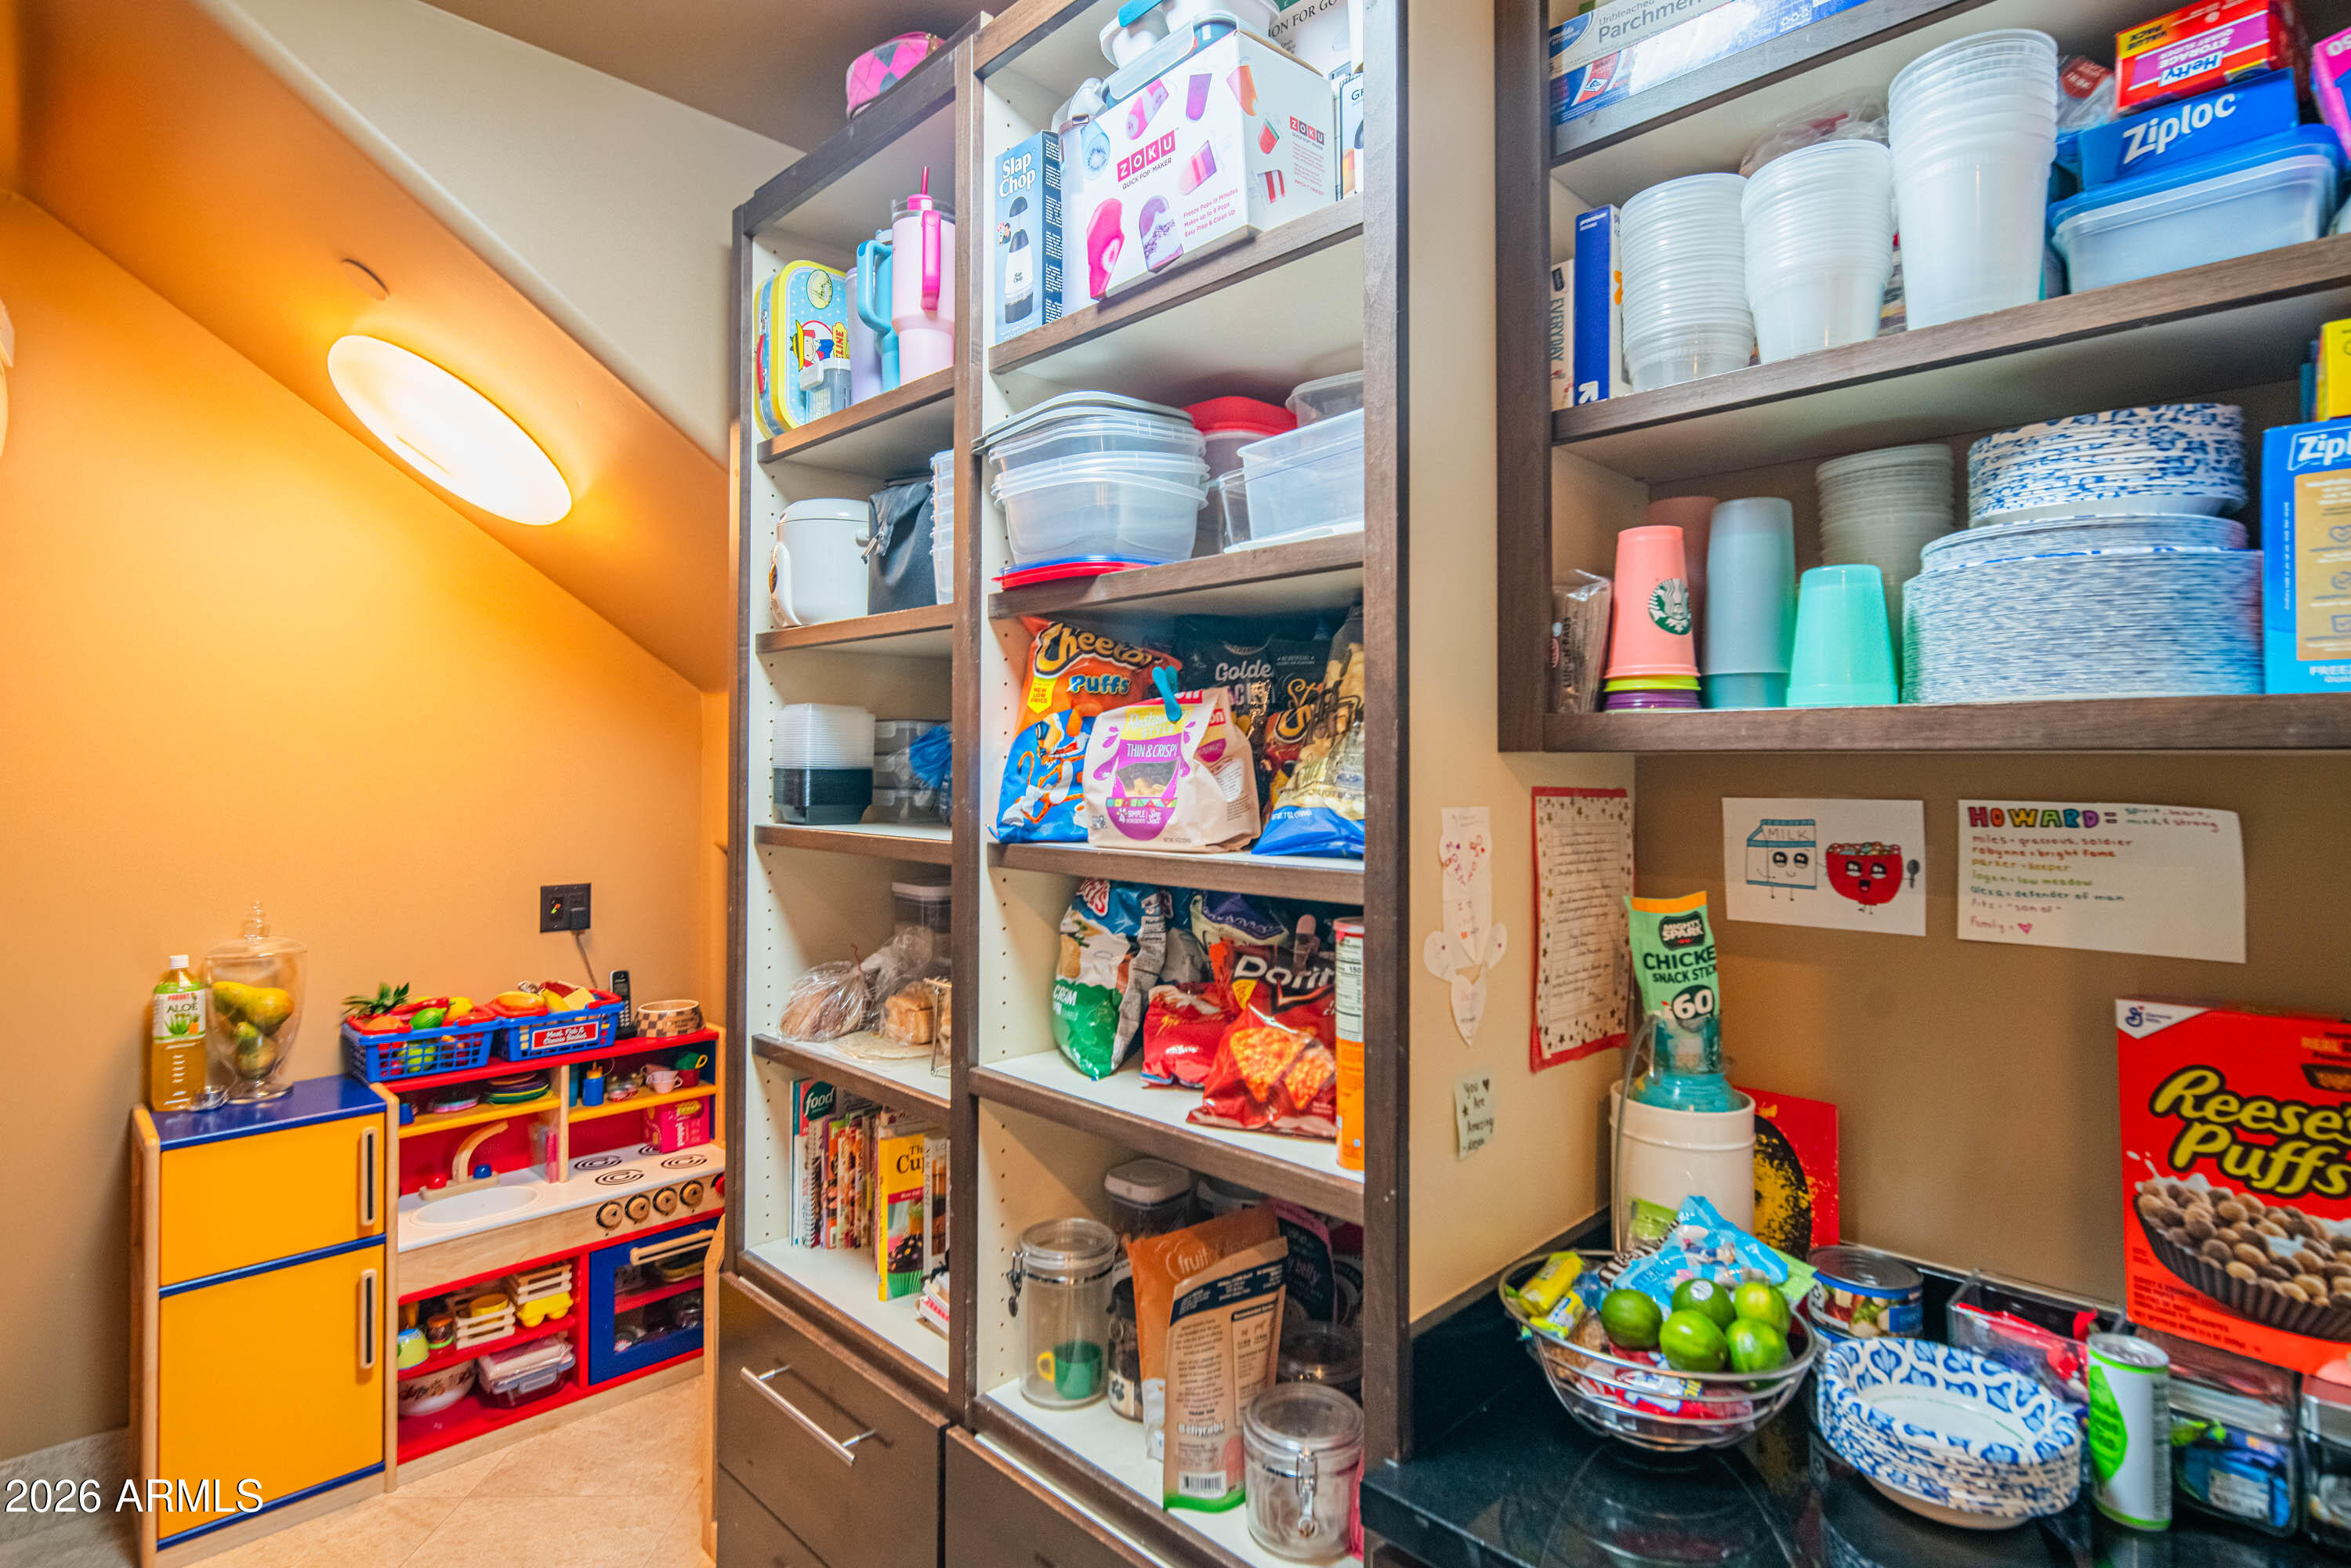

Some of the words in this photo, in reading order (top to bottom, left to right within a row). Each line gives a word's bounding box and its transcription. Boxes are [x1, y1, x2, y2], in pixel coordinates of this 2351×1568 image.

[1292, 5, 1316, 27] FOR
[2157, 37, 2230, 70] STORAGE
[2164, 54, 2219, 81] Hefty
[1291, 118, 1324, 143] ZOKU
[2122, 92, 2236, 165] Ziploc
[1002, 151, 1032, 179] Slap
[1119, 136, 1173, 178] ZOKU
[998, 168, 1036, 199] Chop
[1122, 176, 1139, 190] QUICK
[1139, 169, 1151, 180] POP
[1152, 158, 1172, 172] MAKER
[1183, 207, 1199, 218] Freeze
[1201, 201, 1212, 211] Pops
[1219, 188, 1238, 201] Minutes
[1184, 217, 1198, 227] Makes
[1218, 202, 1230, 212] Pops
[1185, 227, 1196, 237] Easy
[1197, 223, 1208, 235] Prep
[1213, 214, 1227, 224] Clean
[1229, 209, 1236, 219] Up
[1070, 675, 1130, 694] Puffs
[1141, 726, 1174, 738] STYLE
[1127, 743, 1145, 758] THIN
[1146, 744, 1153, 757] &
[1153, 743, 1179, 758] CRISPY
[1968, 806, 2099, 828] HOWARD
[1768, 827, 1810, 842] MILK
[1349, 965, 1362, 975] 150
[1652, 971, 1690, 983] SNACK
[166, 1003, 198, 1013] ALOE
[1673, 989, 1713, 1020] 60
[804, 1088, 834, 1117] food
[2173, 1122, 2351, 1195] Puffs
